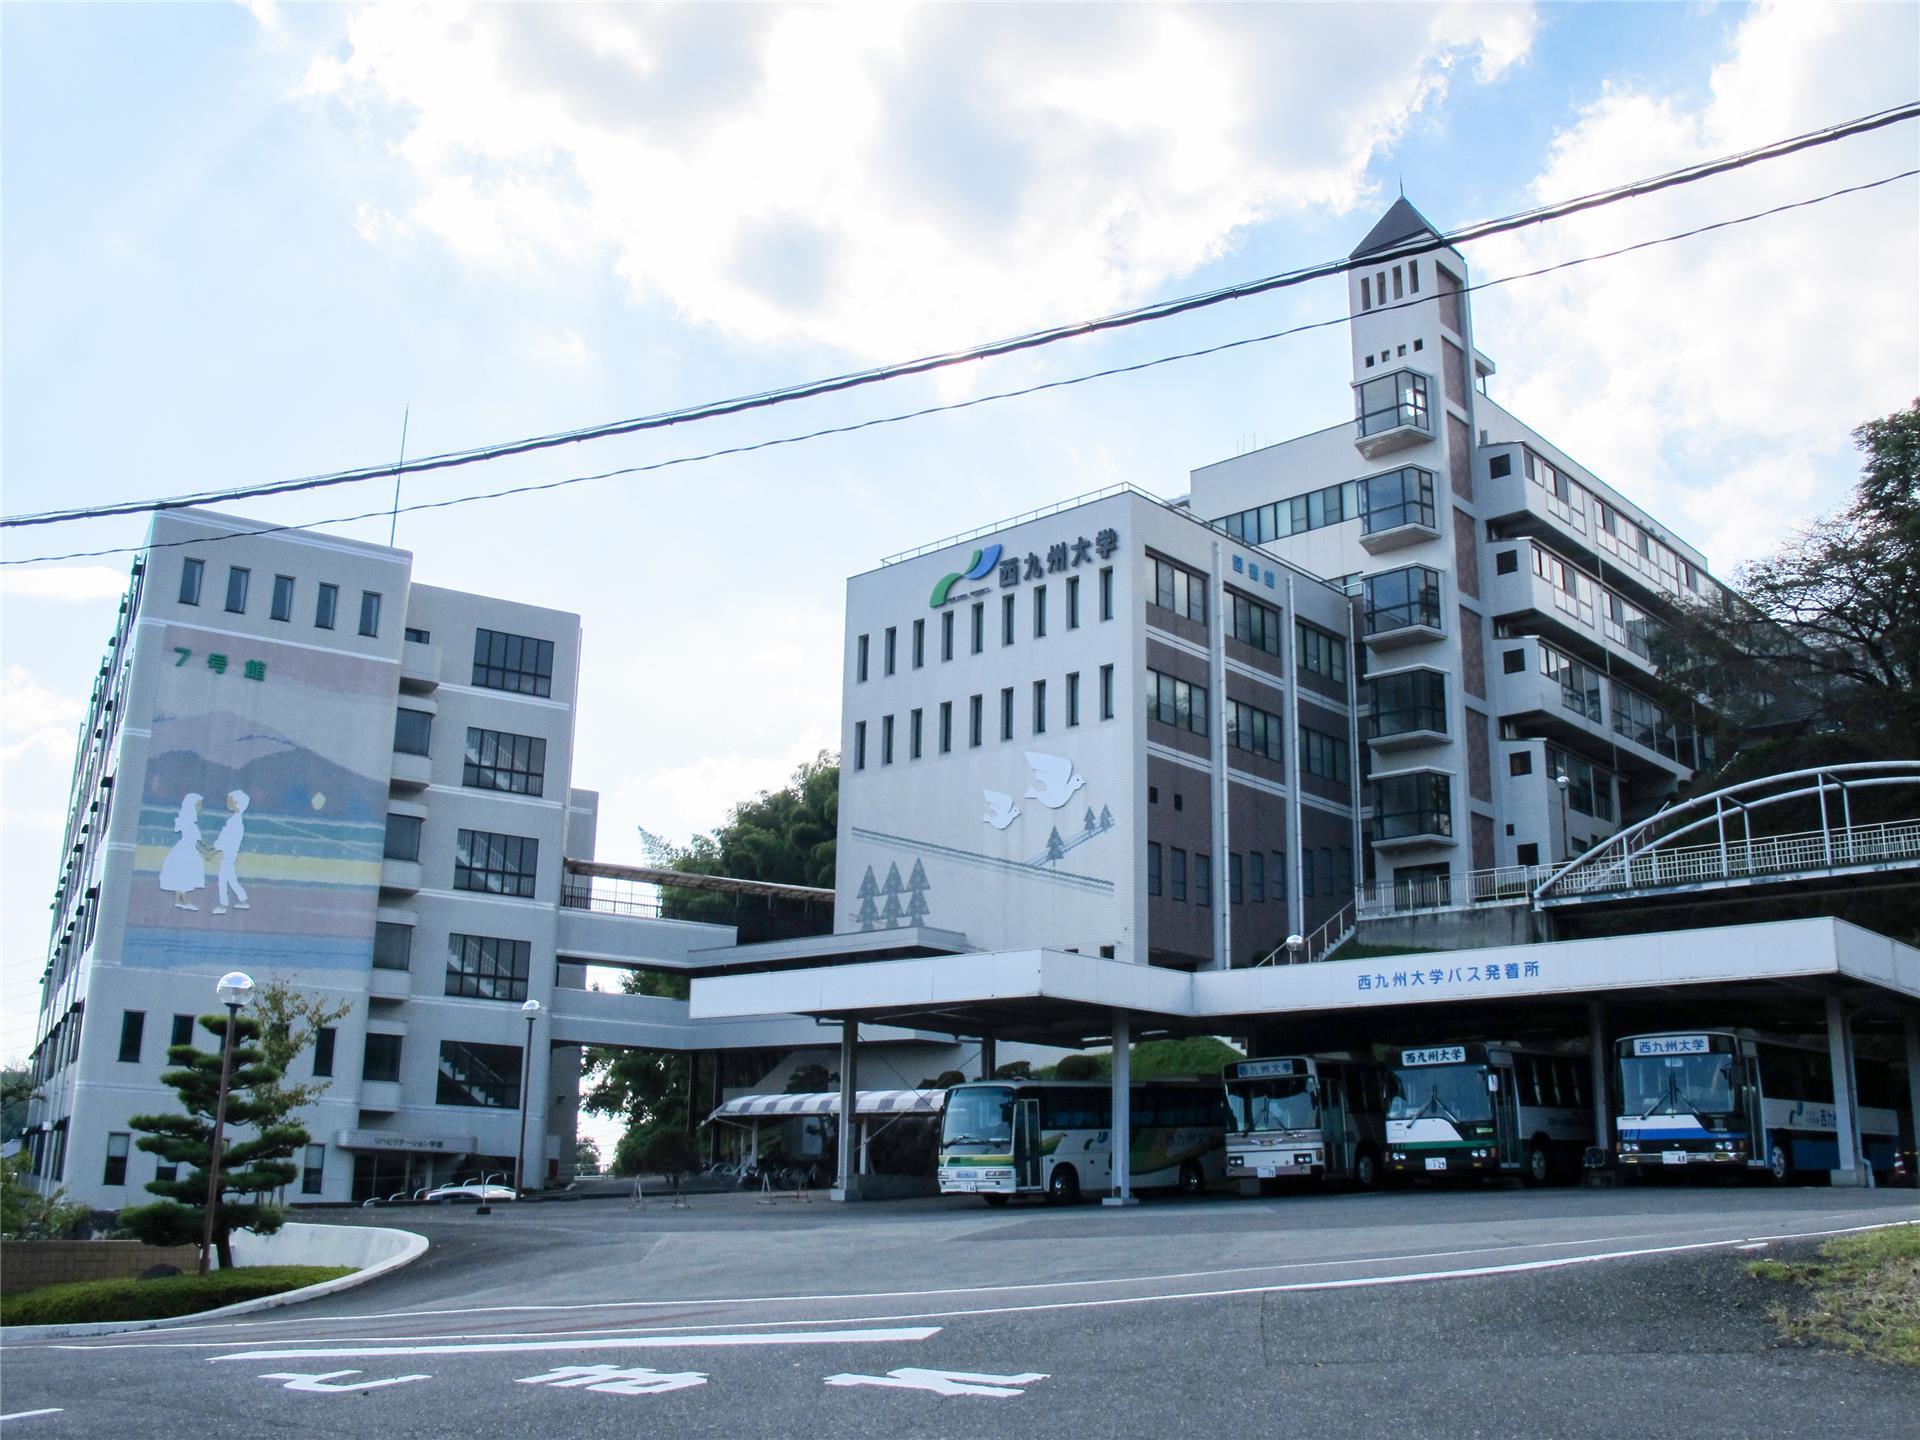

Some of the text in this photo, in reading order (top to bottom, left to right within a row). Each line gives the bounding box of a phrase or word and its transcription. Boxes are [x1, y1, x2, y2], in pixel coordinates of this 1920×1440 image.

[1000, 528, 1118, 588] 西九州大学
[174, 646, 267, 682] 7号館
[1357, 960, 1541, 991] 西九州大学バス発着所
[1404, 1048, 1463, 1063] 西九州大学
[1639, 1038, 1705, 1054] 西九州大学
[1239, 1061, 1292, 1076] 西九州大学
